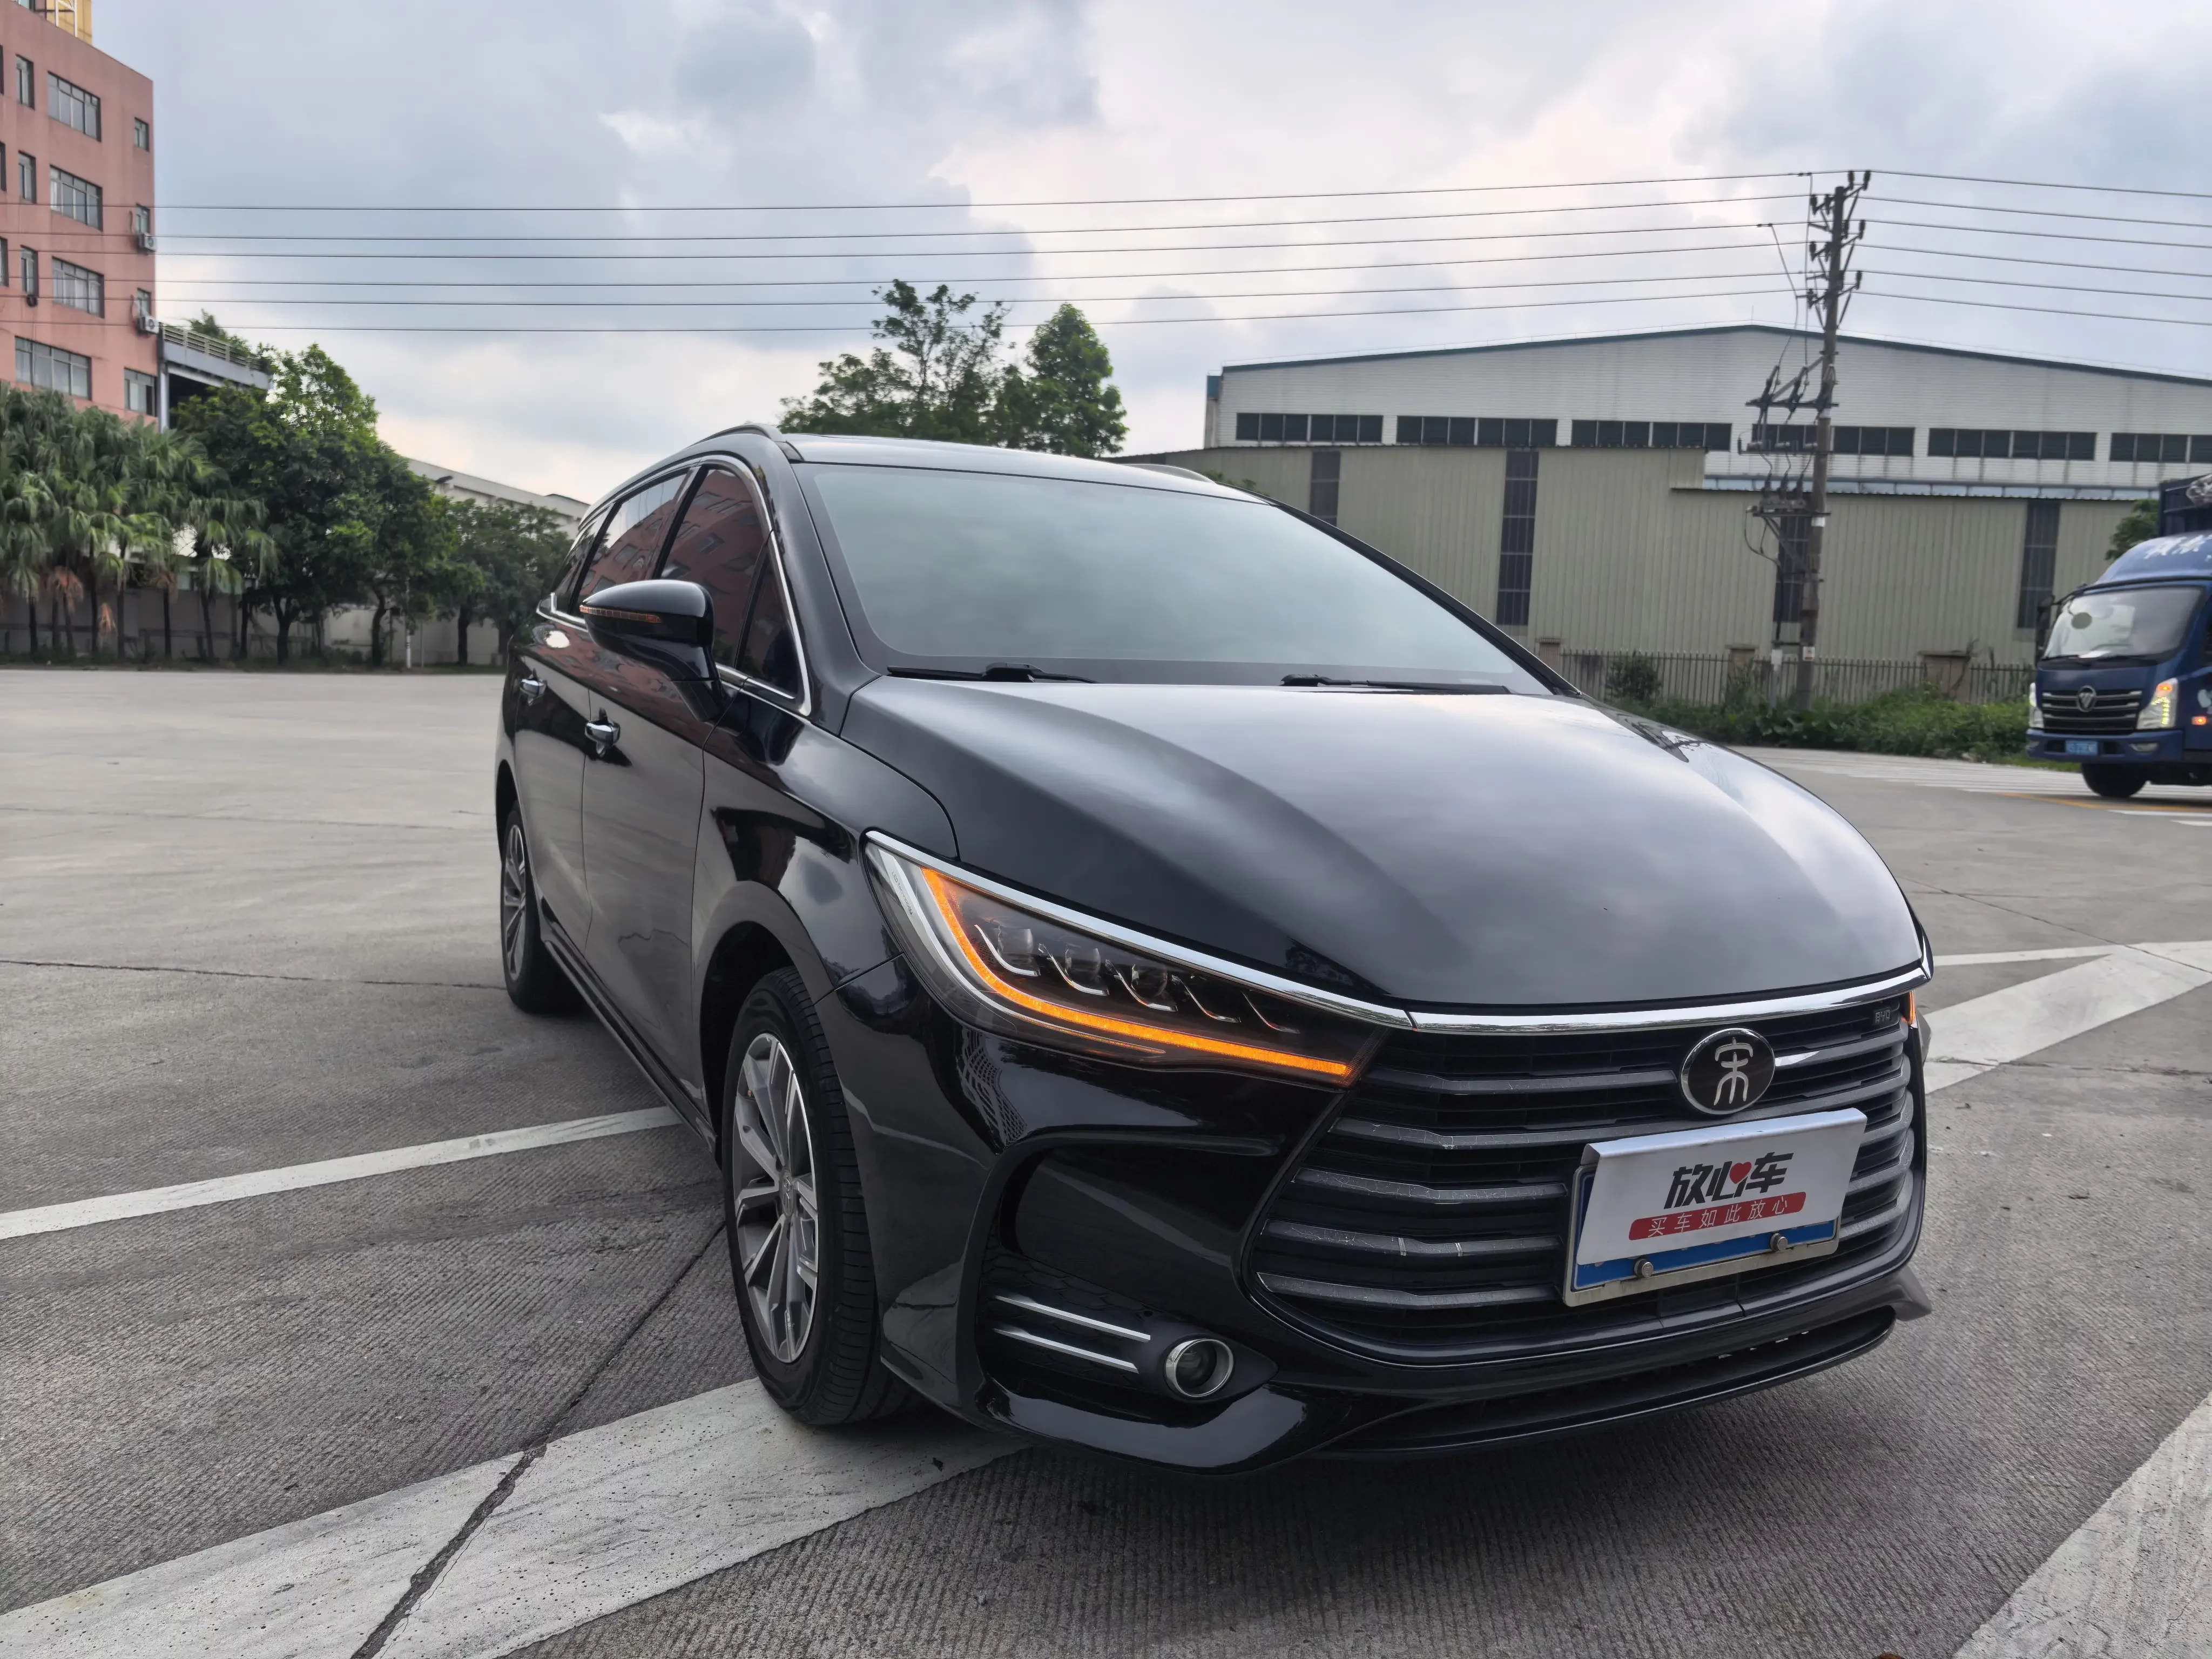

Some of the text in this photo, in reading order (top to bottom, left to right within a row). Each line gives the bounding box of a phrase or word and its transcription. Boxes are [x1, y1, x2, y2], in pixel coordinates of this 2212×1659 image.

[1664, 1152, 1794, 1209] 放心车
[1648, 1196, 1787, 1237] 买车如此放心
